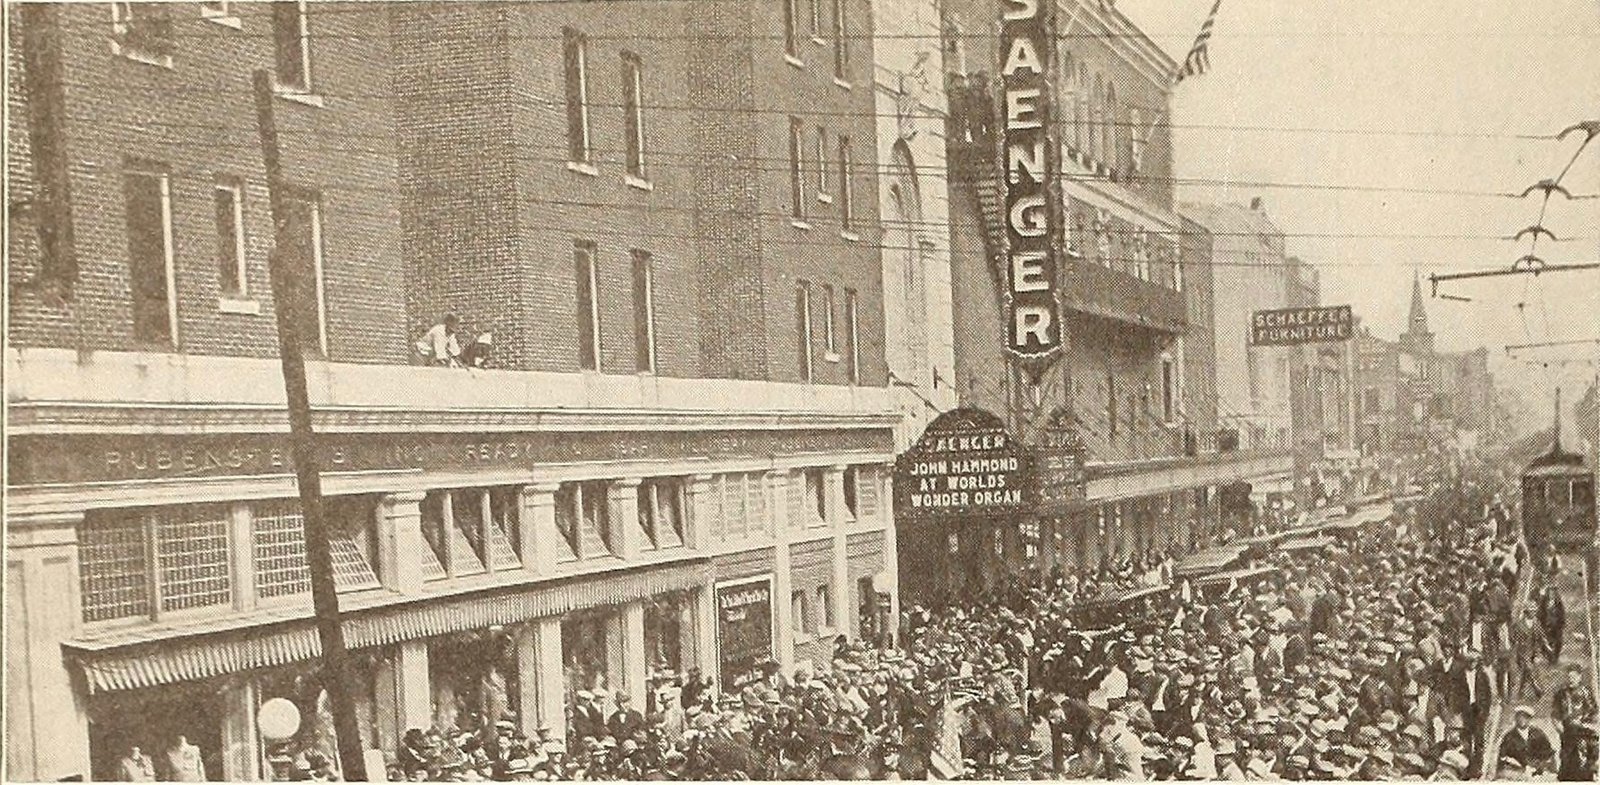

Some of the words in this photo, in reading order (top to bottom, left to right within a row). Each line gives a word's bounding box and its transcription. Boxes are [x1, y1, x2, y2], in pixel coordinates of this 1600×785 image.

[1258, 324, 1348, 341] FURNITURE
[910, 460, 948, 475] JOHN
[951, 457, 1018, 474] HAMMOND
[920, 477, 937, 492] AT
[946, 474, 1006, 490] WORLDS
[910, 491, 969, 508] WONDER
[974, 489, 1021, 506] ORGAN
